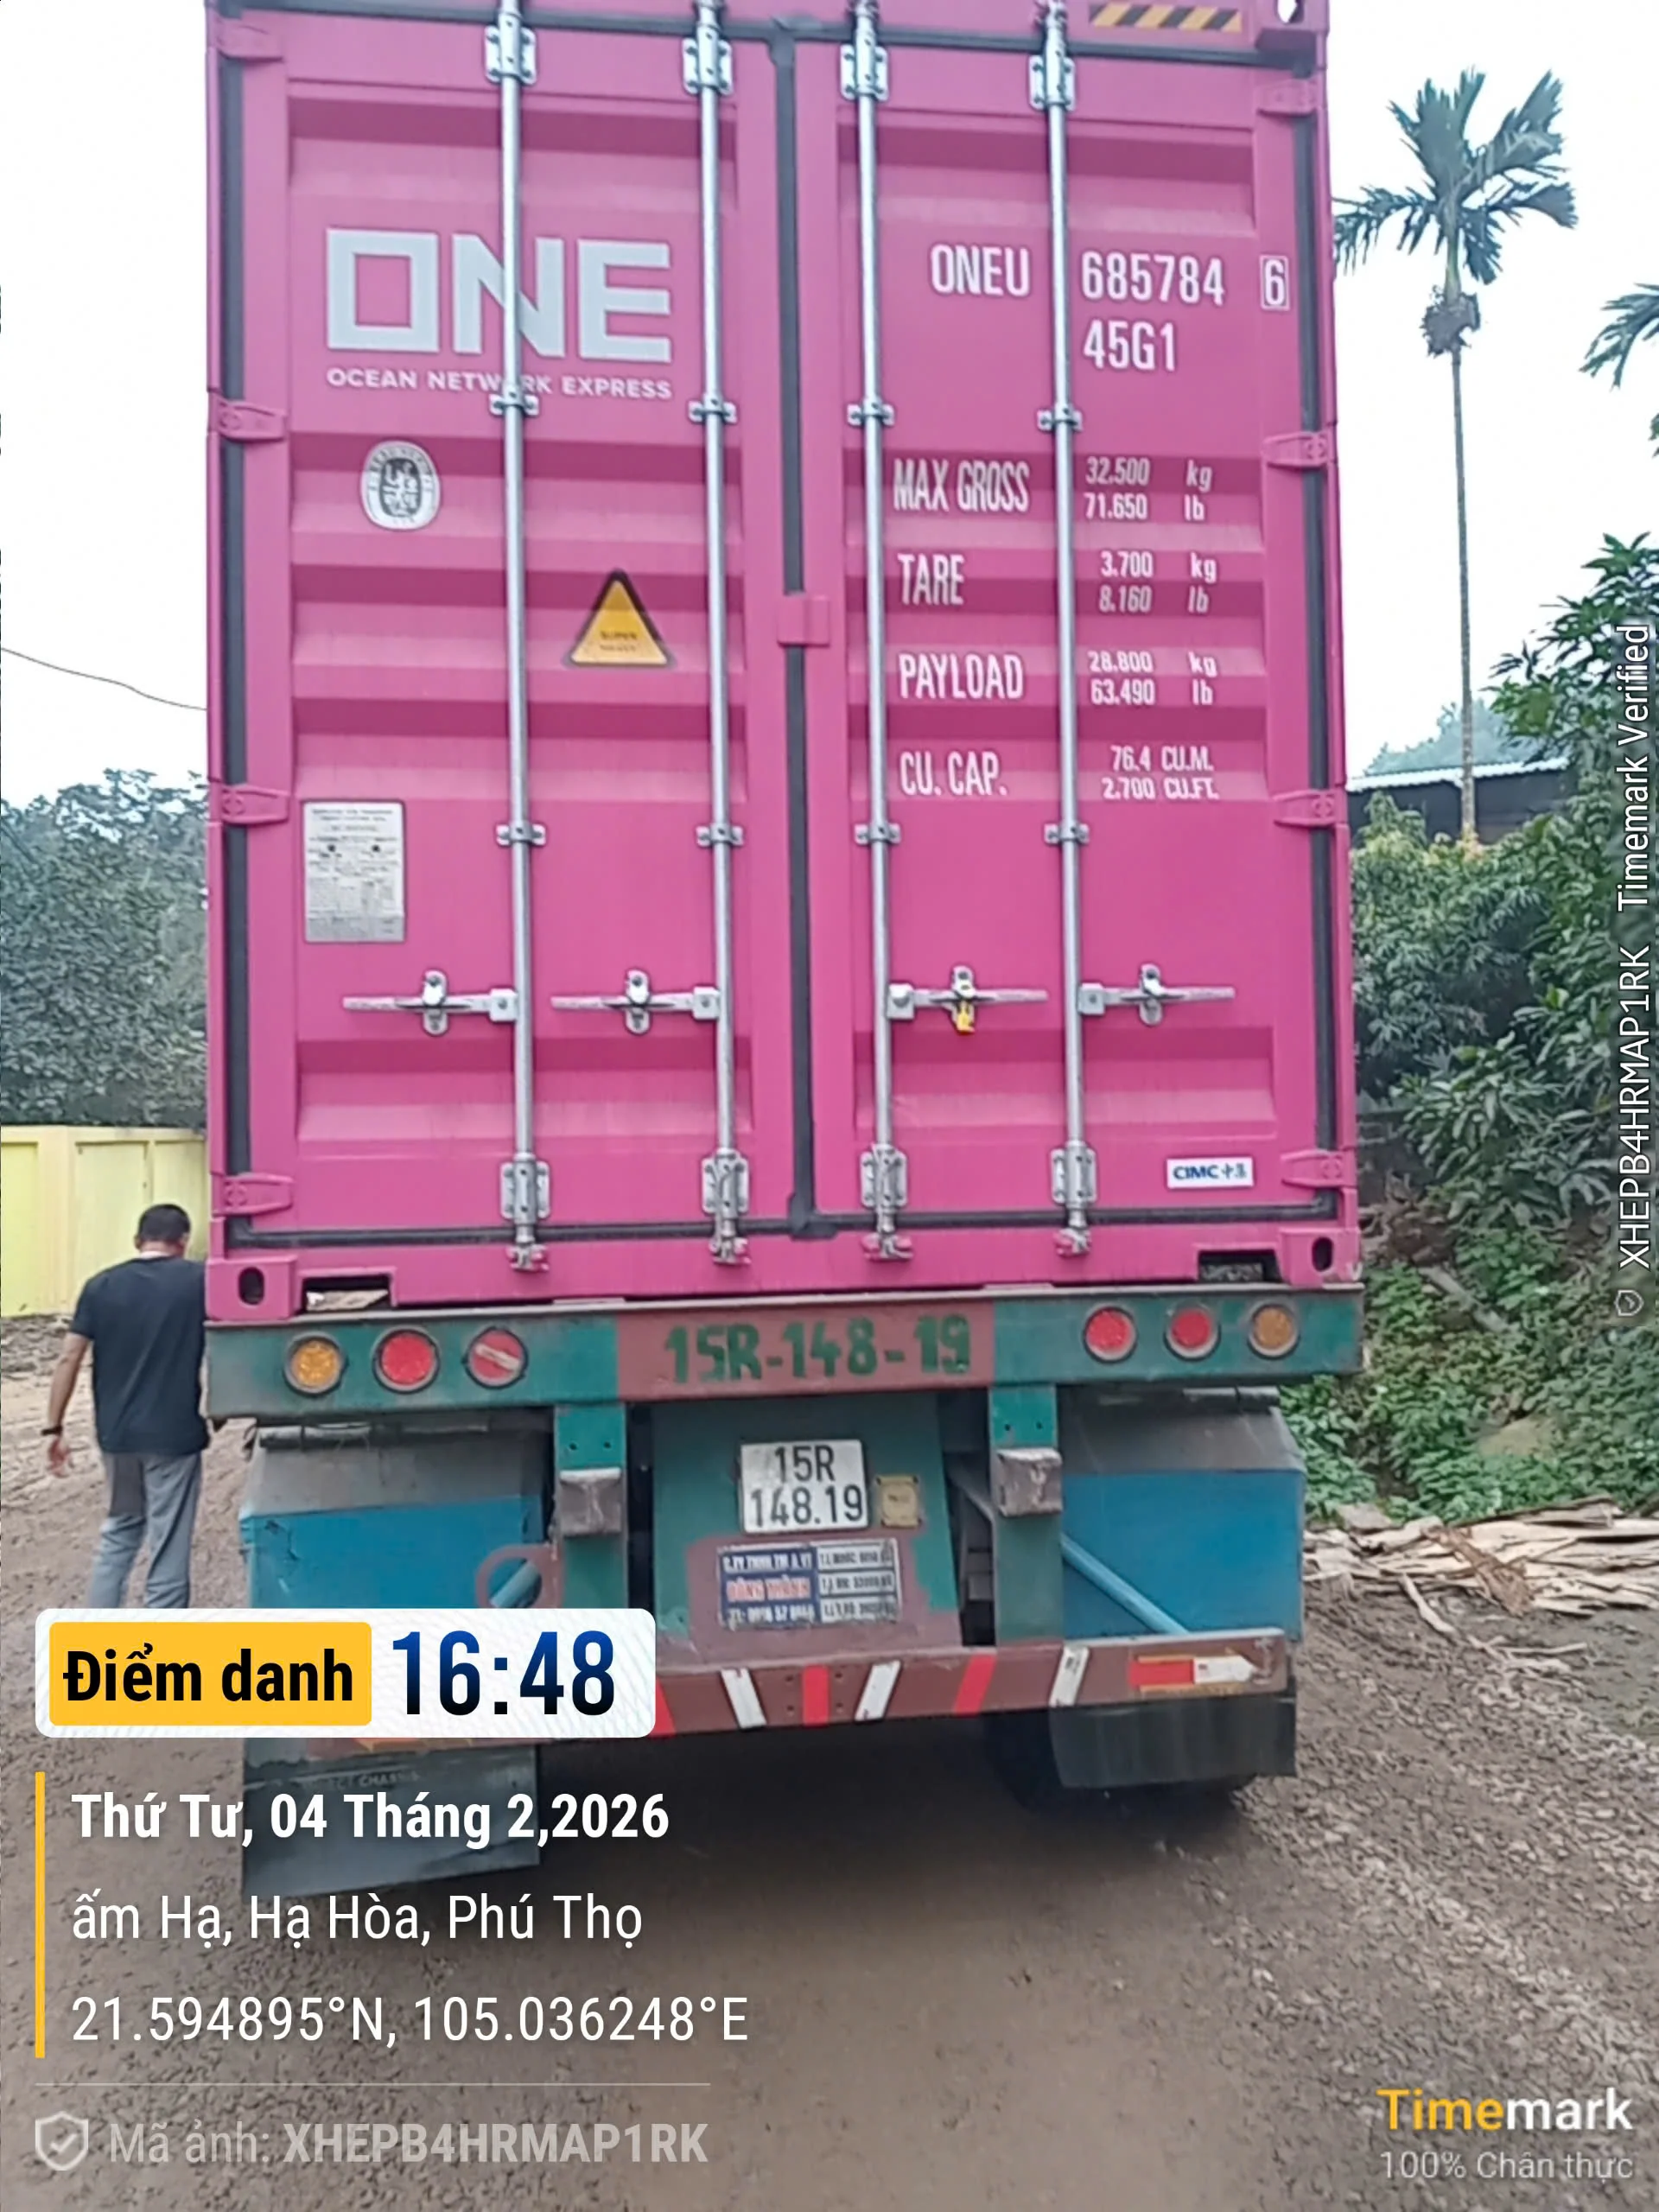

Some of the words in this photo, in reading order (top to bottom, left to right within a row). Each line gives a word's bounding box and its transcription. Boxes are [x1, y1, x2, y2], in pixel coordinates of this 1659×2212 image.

[327, 228, 671, 363] ONE
[931, 245, 1030, 296] ONEU
[1082, 251, 1224, 306] 685784
[1263, 257, 1287, 308] 6
[1084, 321, 1175, 370] 45G1
[327, 368, 416, 390] OCEAN
[428, 372, 551, 394] NETWRK
[563, 377, 671, 398] EXPRESS
[893, 460, 949, 511] MAX
[957, 461, 1030, 512] GROSS
[1085, 457, 1150, 486] 32.500
[1187, 461, 1212, 493] kg
[1084, 493, 1147, 520] 71.650
[1185, 495, 1205, 520] lb
[898, 553, 964, 605] TARE
[1101, 551, 1153, 578] 3.700
[1191, 554, 1217, 583] kg
[1100, 586, 1151, 613] 8.160
[1189, 587, 1208, 613] lb
[899, 653, 1023, 699] PAYLOAD
[1088, 652, 1153, 673] 28.800
[1188, 652, 1217, 677] kg
[1090, 679, 1154, 705] 63.490
[1192, 680, 1212, 705] lb
[900, 752, 941, 795] CU.
[949, 753, 1007, 796] CAP.
[1111, 746, 1151, 772] 76.4
[1103, 778, 1155, 799] 2.700
[1173, 1164, 1219, 1180] CIMC
[665, 1314, 971, 1382] 15R-148-19
[775, 1445, 835, 1483] 15R
[751, 1485, 863, 1528] 148.19
